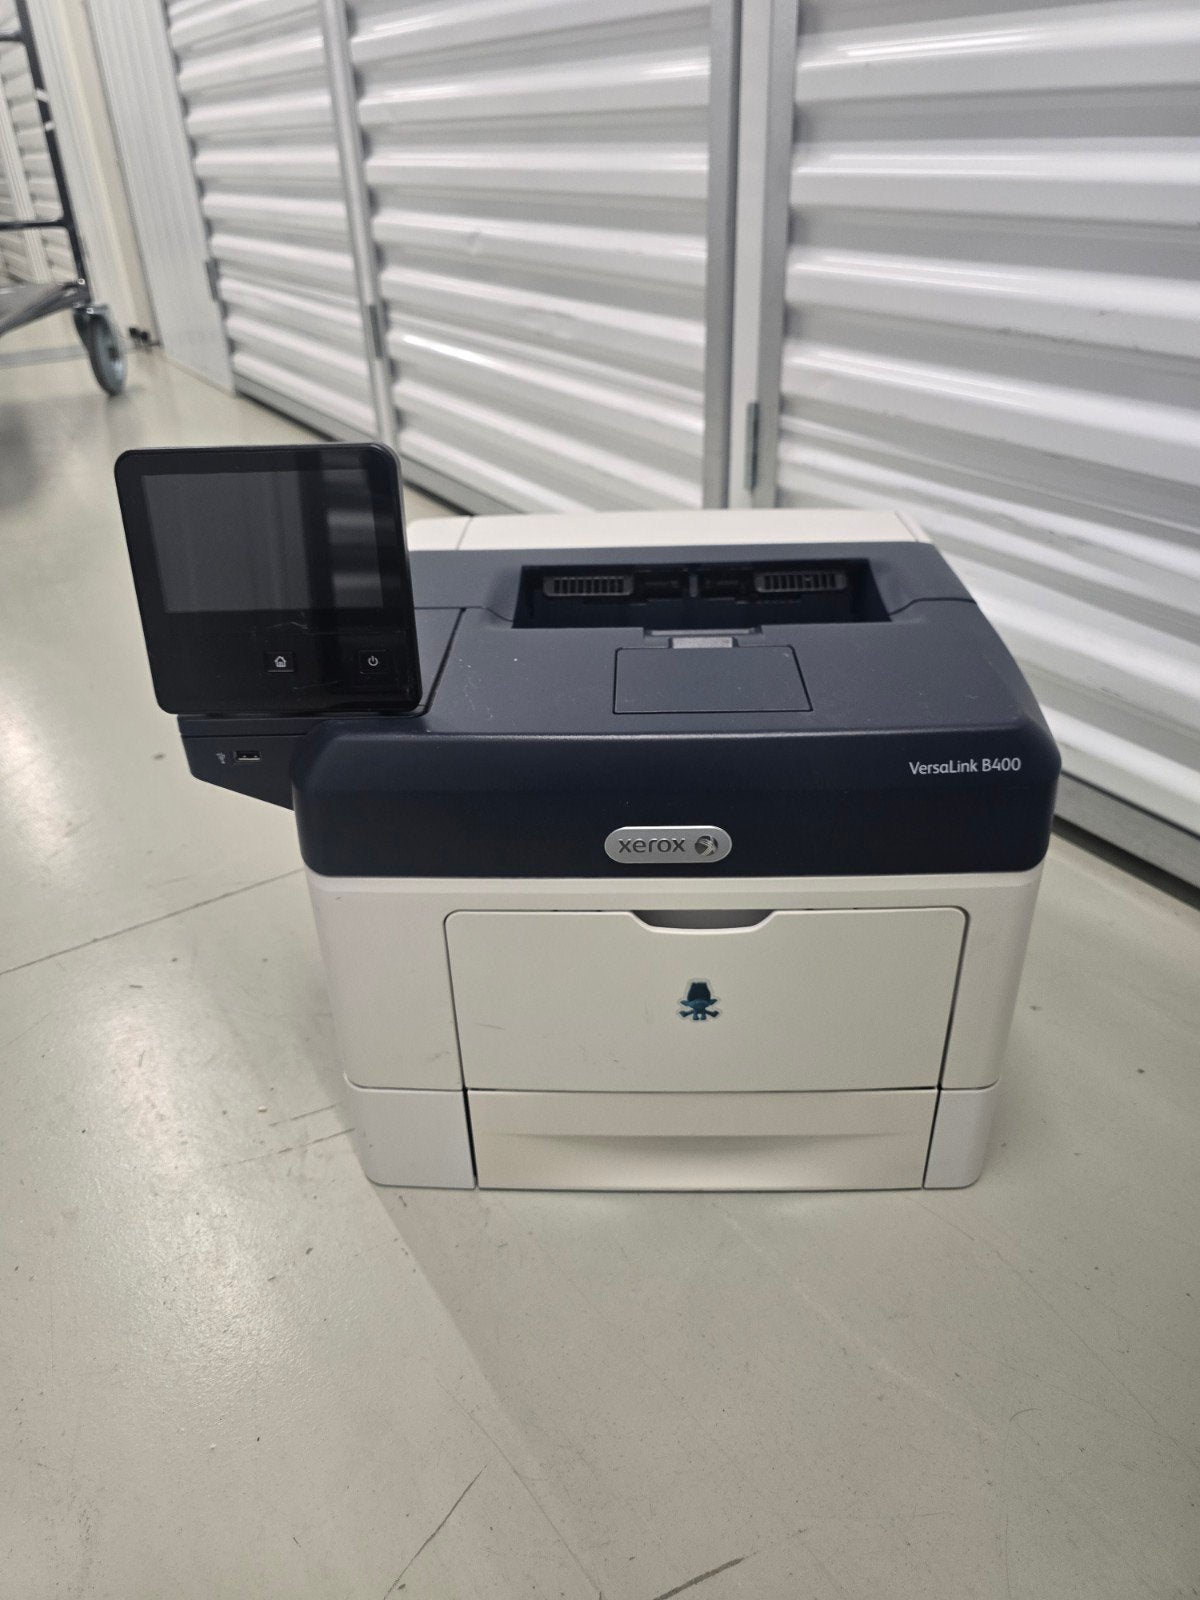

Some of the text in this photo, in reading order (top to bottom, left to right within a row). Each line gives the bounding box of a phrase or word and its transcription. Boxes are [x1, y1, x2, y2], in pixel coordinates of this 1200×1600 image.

[909, 757, 1022, 775] VersaLink B400
[618, 838, 686, 853] xerox
